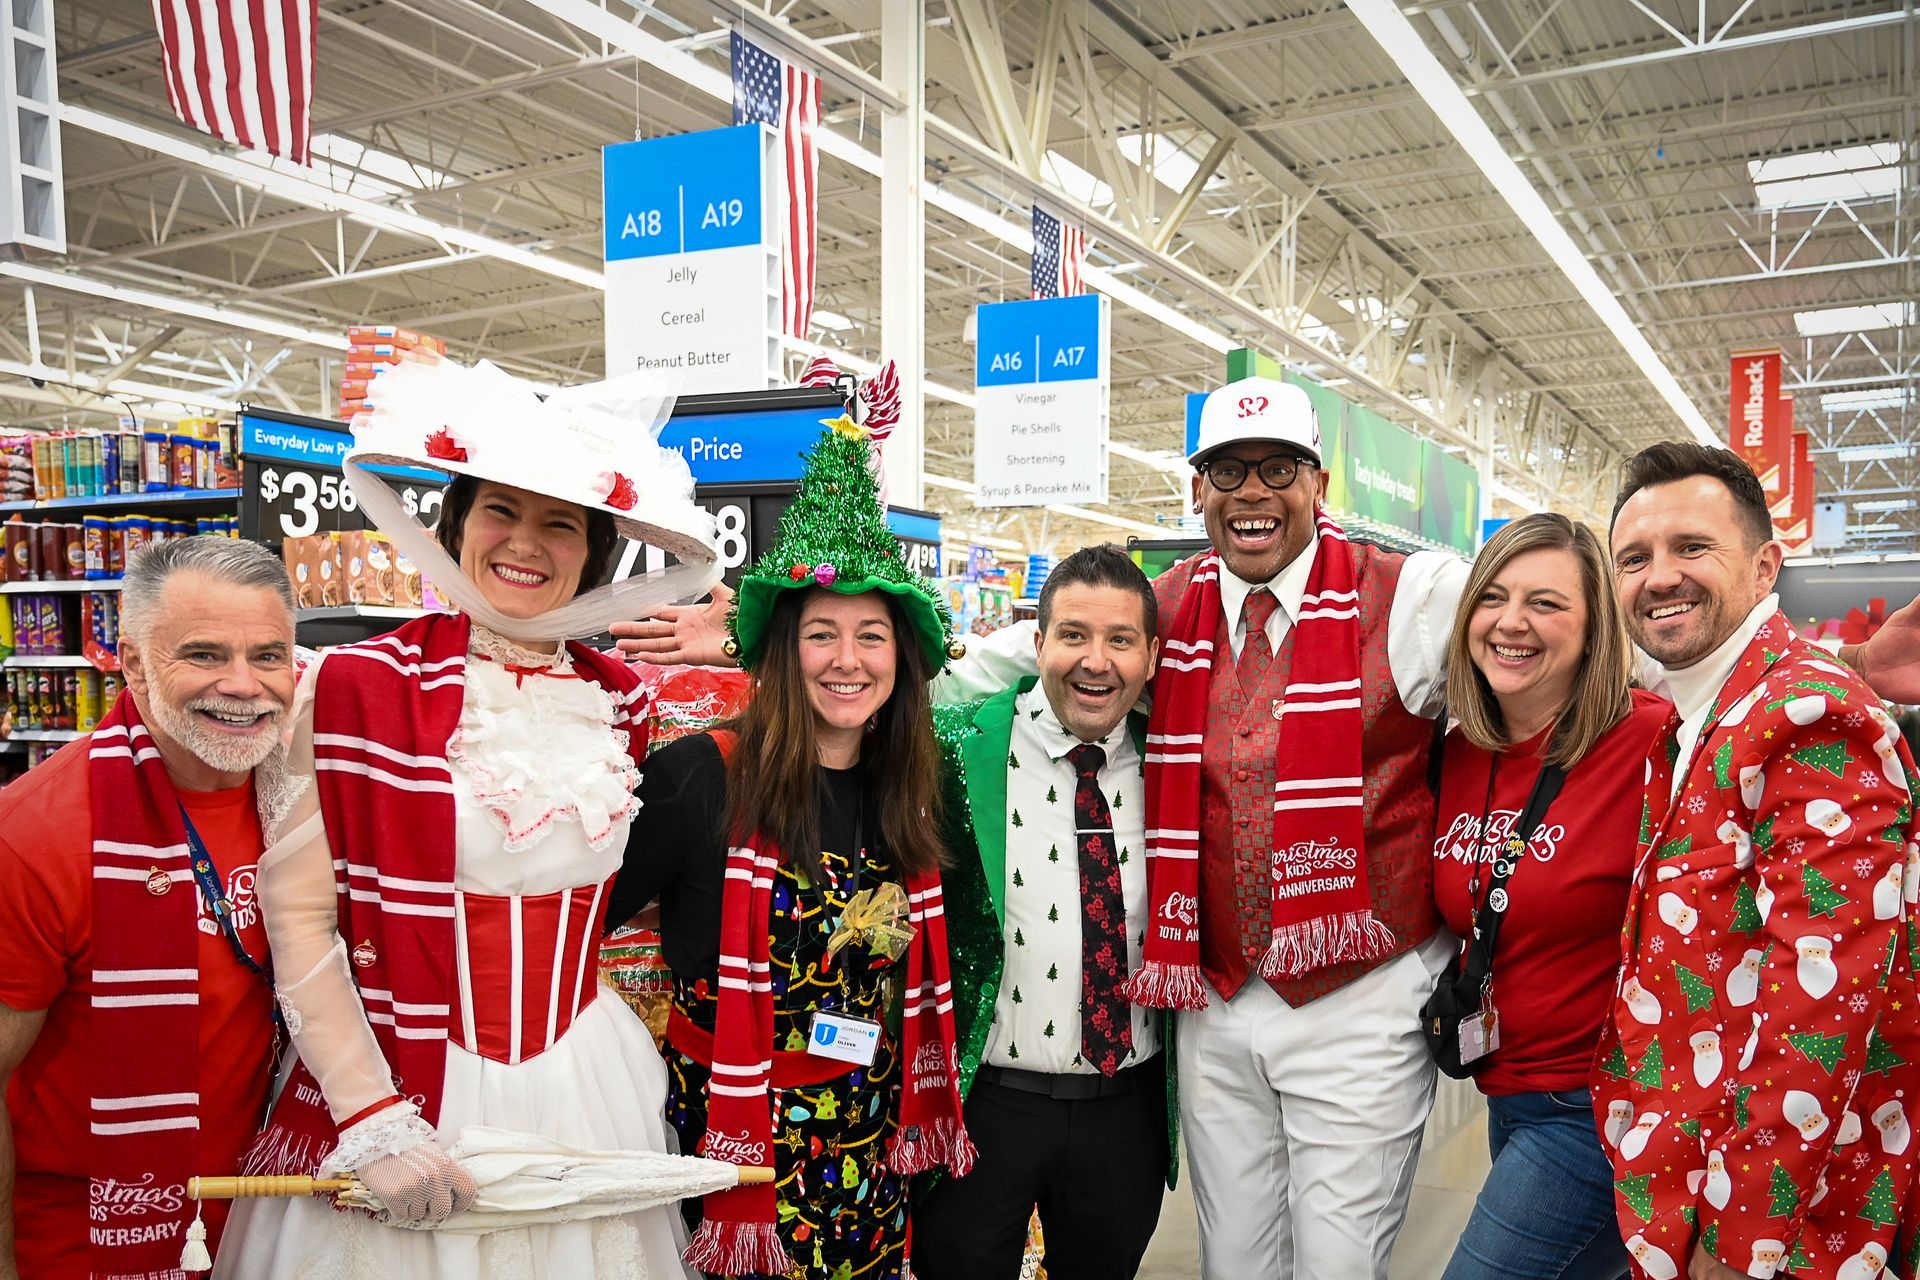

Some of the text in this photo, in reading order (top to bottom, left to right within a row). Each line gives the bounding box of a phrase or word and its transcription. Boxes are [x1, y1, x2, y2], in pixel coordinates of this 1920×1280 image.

[701, 199, 743, 229] A19
[621, 210, 662, 240] A18
[667, 267, 697, 285] Jelly
[661, 308, 705, 326] Cereal
[637, 350, 731, 370] Peanut Butter
[990, 351, 1022, 373] A16
[1053, 346, 1085, 368] A17
[1016, 392, 1057, 406] Vinegar
[1744, 359, 1764, 447] Rollback
[1011, 422, 1062, 435] Pie Shells
[255, 428, 309, 454] Everyday
[312, 438, 334, 454] Low
[691, 436, 743, 461] Price
[1006, 455, 1065, 467] Shortening
[981, 481, 1091, 498] Syrup & Pancake Mix
[1272, 836, 1358, 870] hristmas
[1285, 861, 1312, 879] KIDS
[1278, 875, 1357, 900] ANNIVERSARY
[1159, 925, 1182, 941] 10TH
[837, 1039, 857, 1048] OLIVER
[294, 1083, 322, 1107] 10TH
